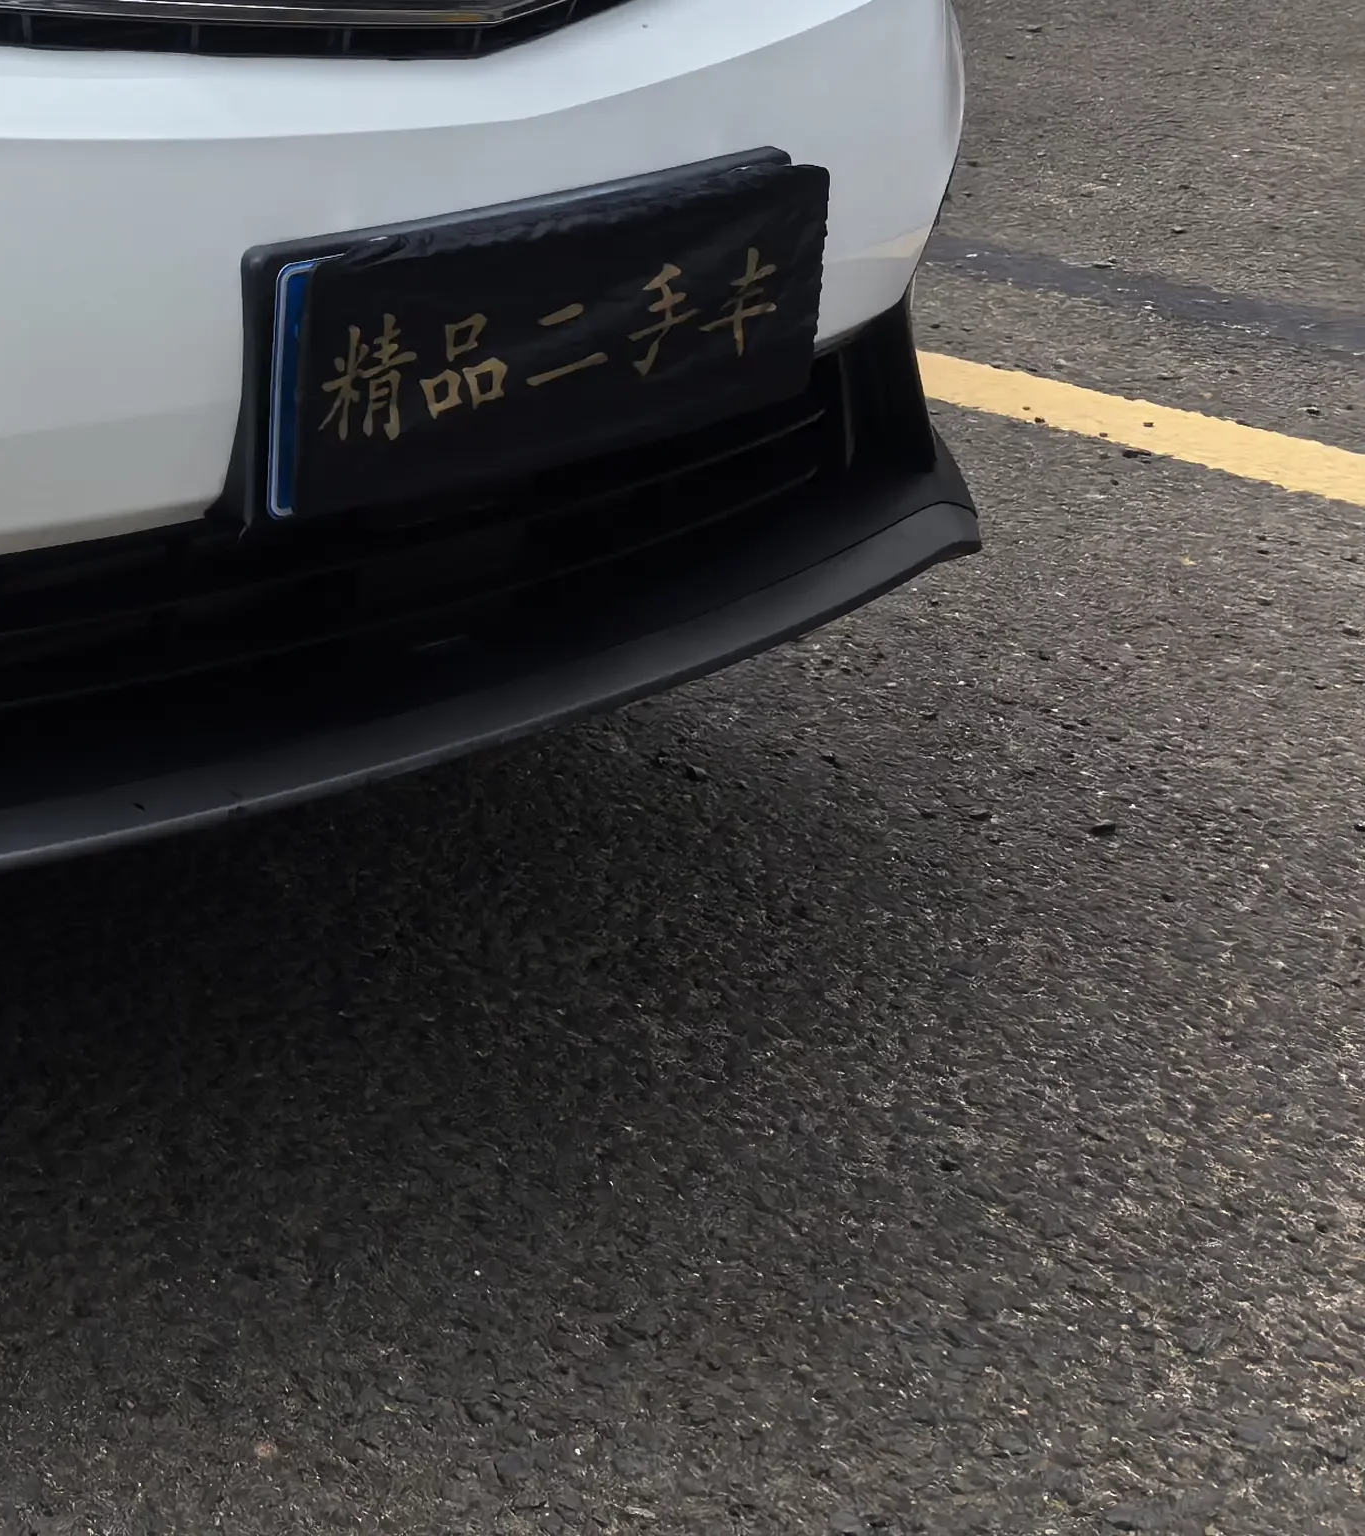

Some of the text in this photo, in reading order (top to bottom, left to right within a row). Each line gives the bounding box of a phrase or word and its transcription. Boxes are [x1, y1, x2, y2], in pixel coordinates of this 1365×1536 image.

[317, 246, 778, 441] 精品二手车
